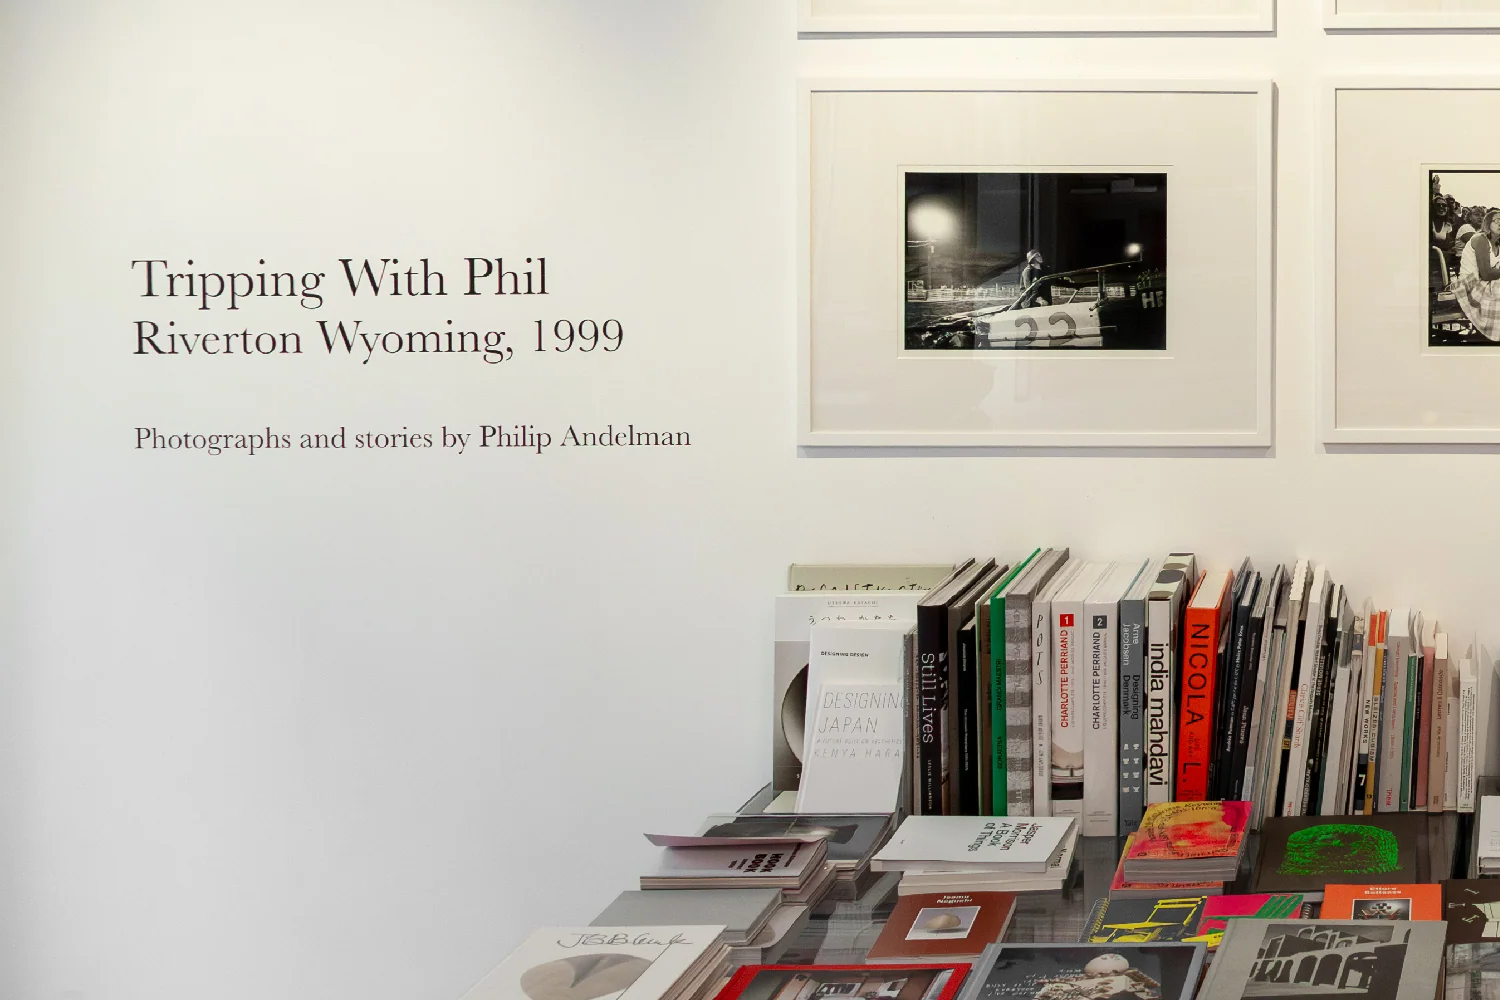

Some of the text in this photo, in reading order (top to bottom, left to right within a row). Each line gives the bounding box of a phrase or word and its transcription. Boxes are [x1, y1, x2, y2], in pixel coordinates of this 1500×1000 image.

[132, 257, 549, 310] Tripping With Phil
[133, 319, 623, 365] Riverton Wyoming, 1999
[134, 425, 691, 455] Photographs and stories by Philip Andelman
[1060, 629, 1068, 674] PERRIAND
[1092, 631, 1101, 730] CHARLOTTE PERRIAND
[1185, 623, 1210, 725] NICOLA
[921, 653, 938, 744] Still Lives
[1122, 674, 1130, 715] Denmark
[1130, 674, 1140, 720] Designing
[818, 717, 878, 734] JAPAN
[1149, 643, 1169, 786] india mahdavi
[815, 749, 900, 758] KENYA HARA
[1182, 762, 1201, 782] L.
[1358, 773, 1366, 786] 7
[968, 830, 991, 852] Things
[987, 829, 1006, 847] Book
[1000, 823, 1029, 850] Morrison
[1025, 823, 1042, 845] Jasper
[743, 854, 768, 873] BOOK
[760, 853, 784, 872] HOOK
